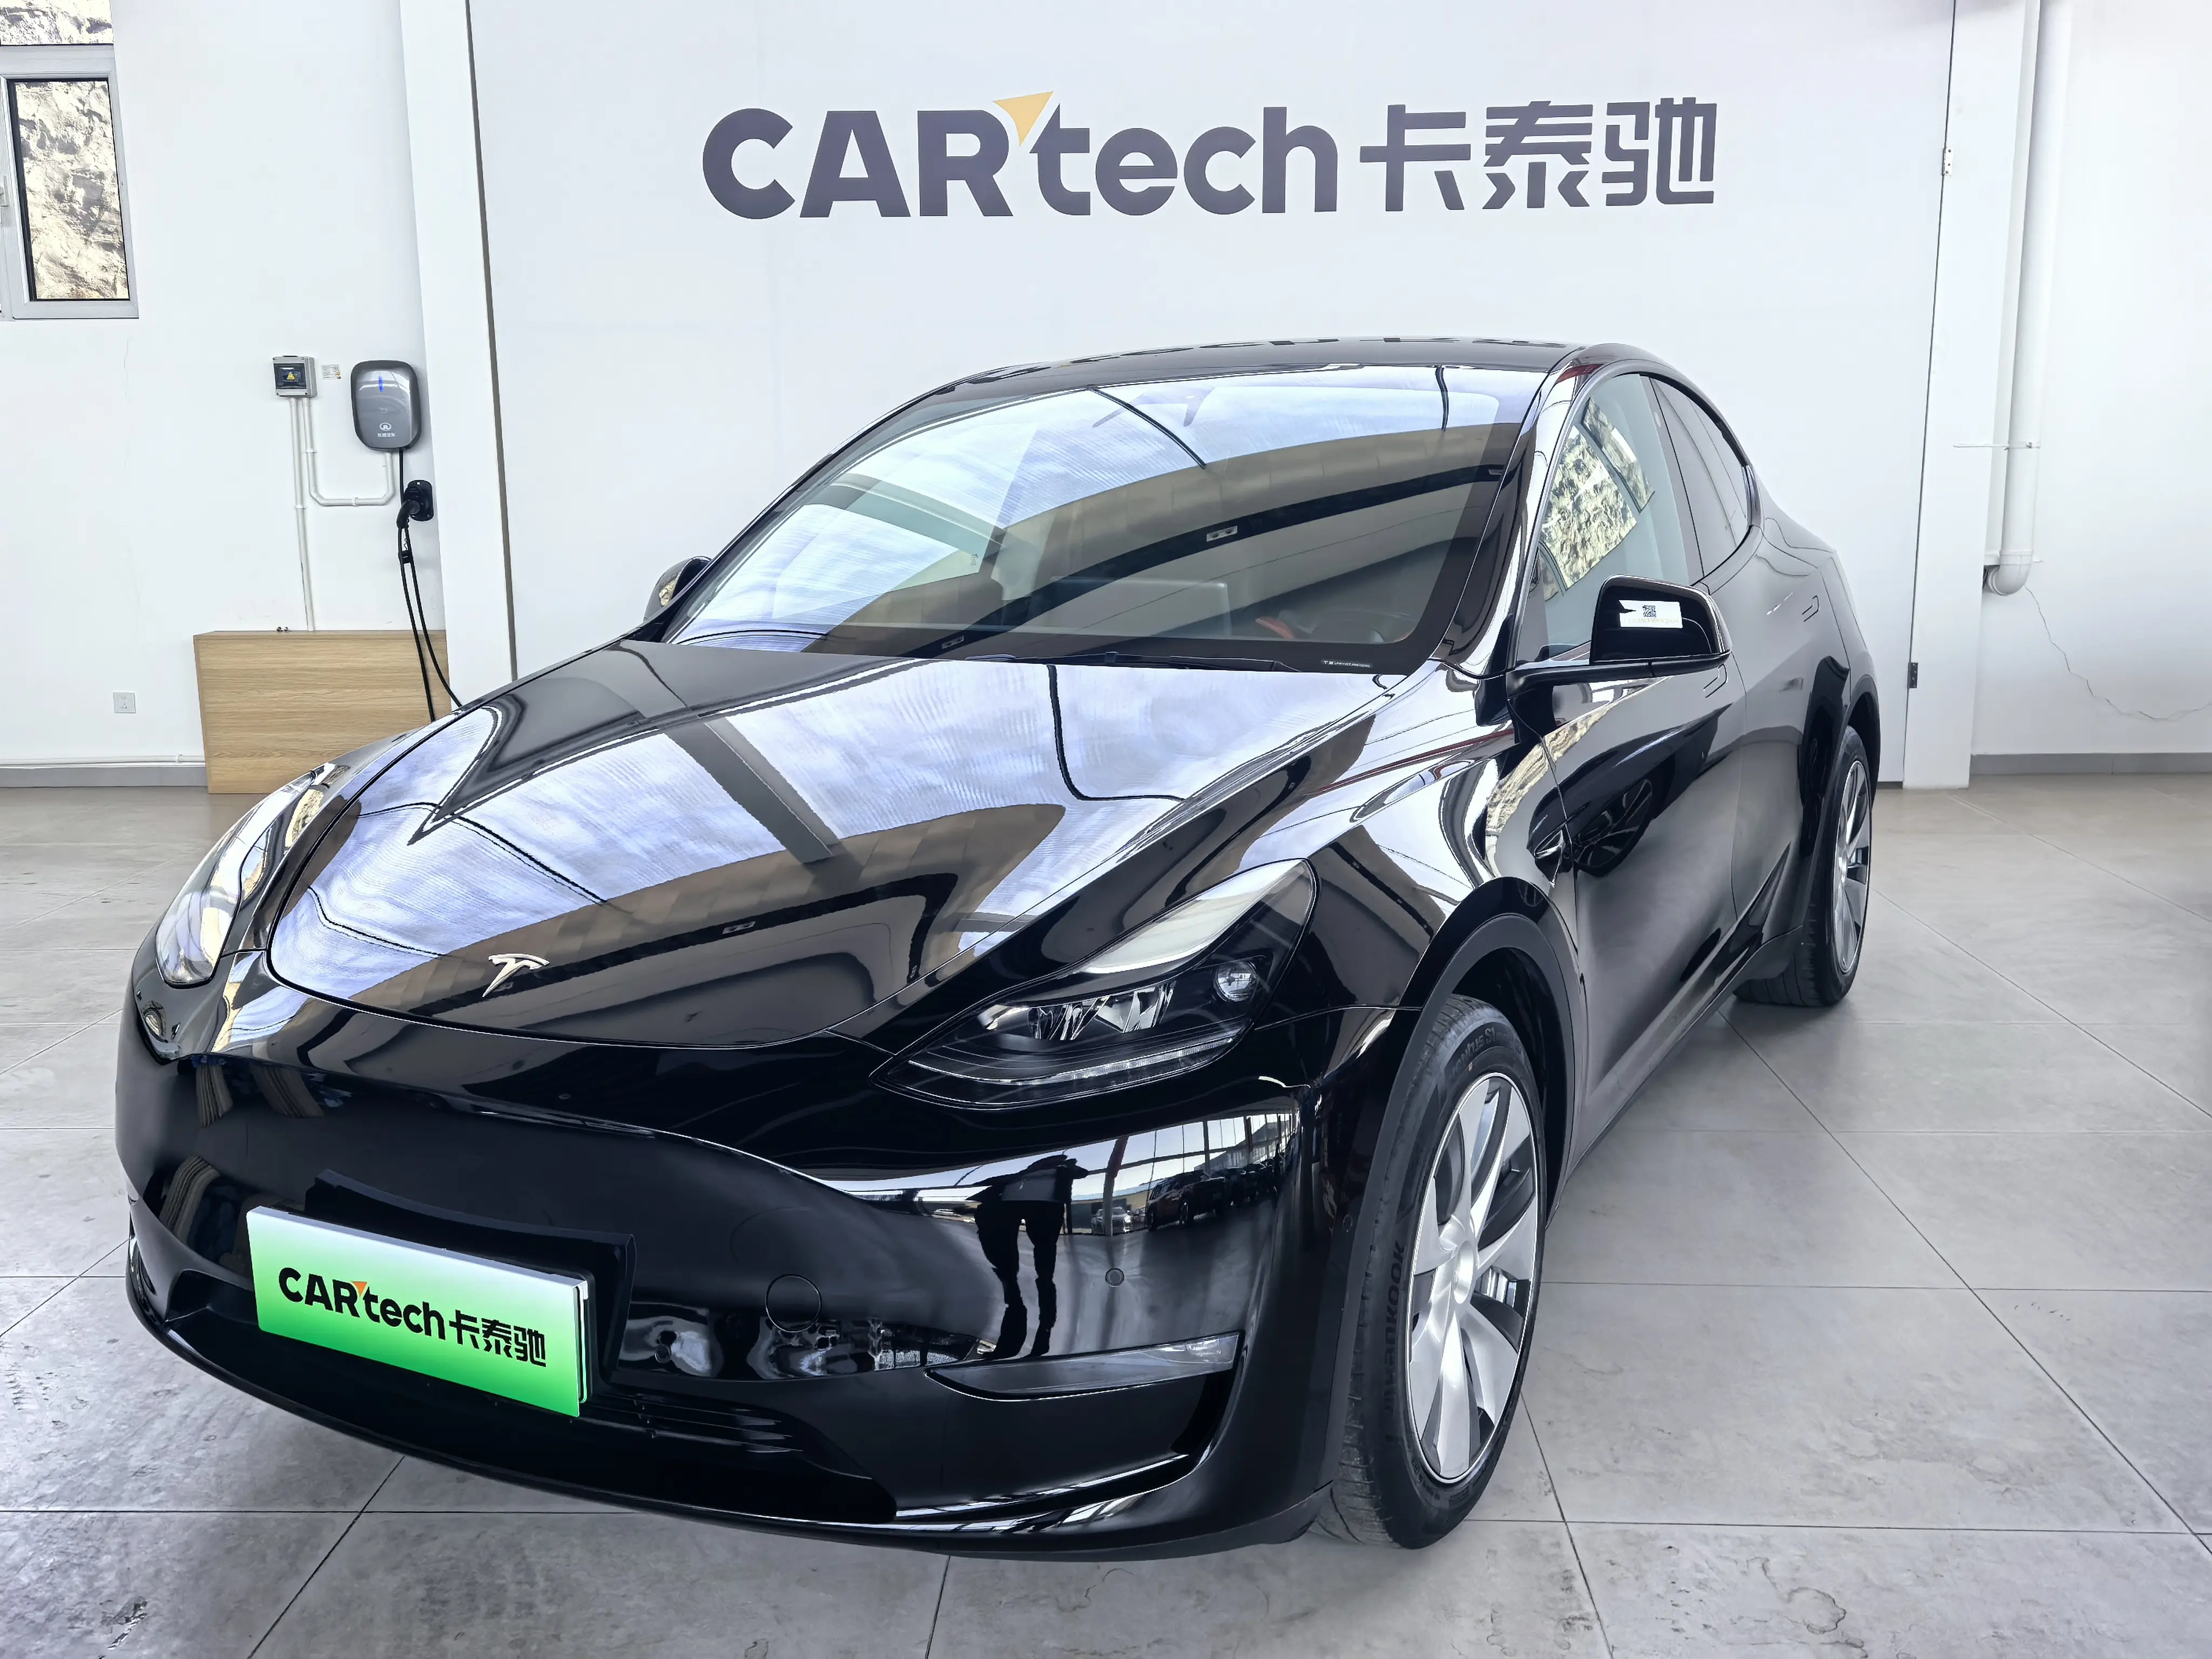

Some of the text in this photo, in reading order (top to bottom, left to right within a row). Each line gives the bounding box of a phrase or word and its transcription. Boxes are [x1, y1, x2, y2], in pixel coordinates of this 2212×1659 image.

[703, 97, 1717, 219] CARtech 卡泰驰
[279, 1267, 547, 1367] CARtech 卡泰驰
